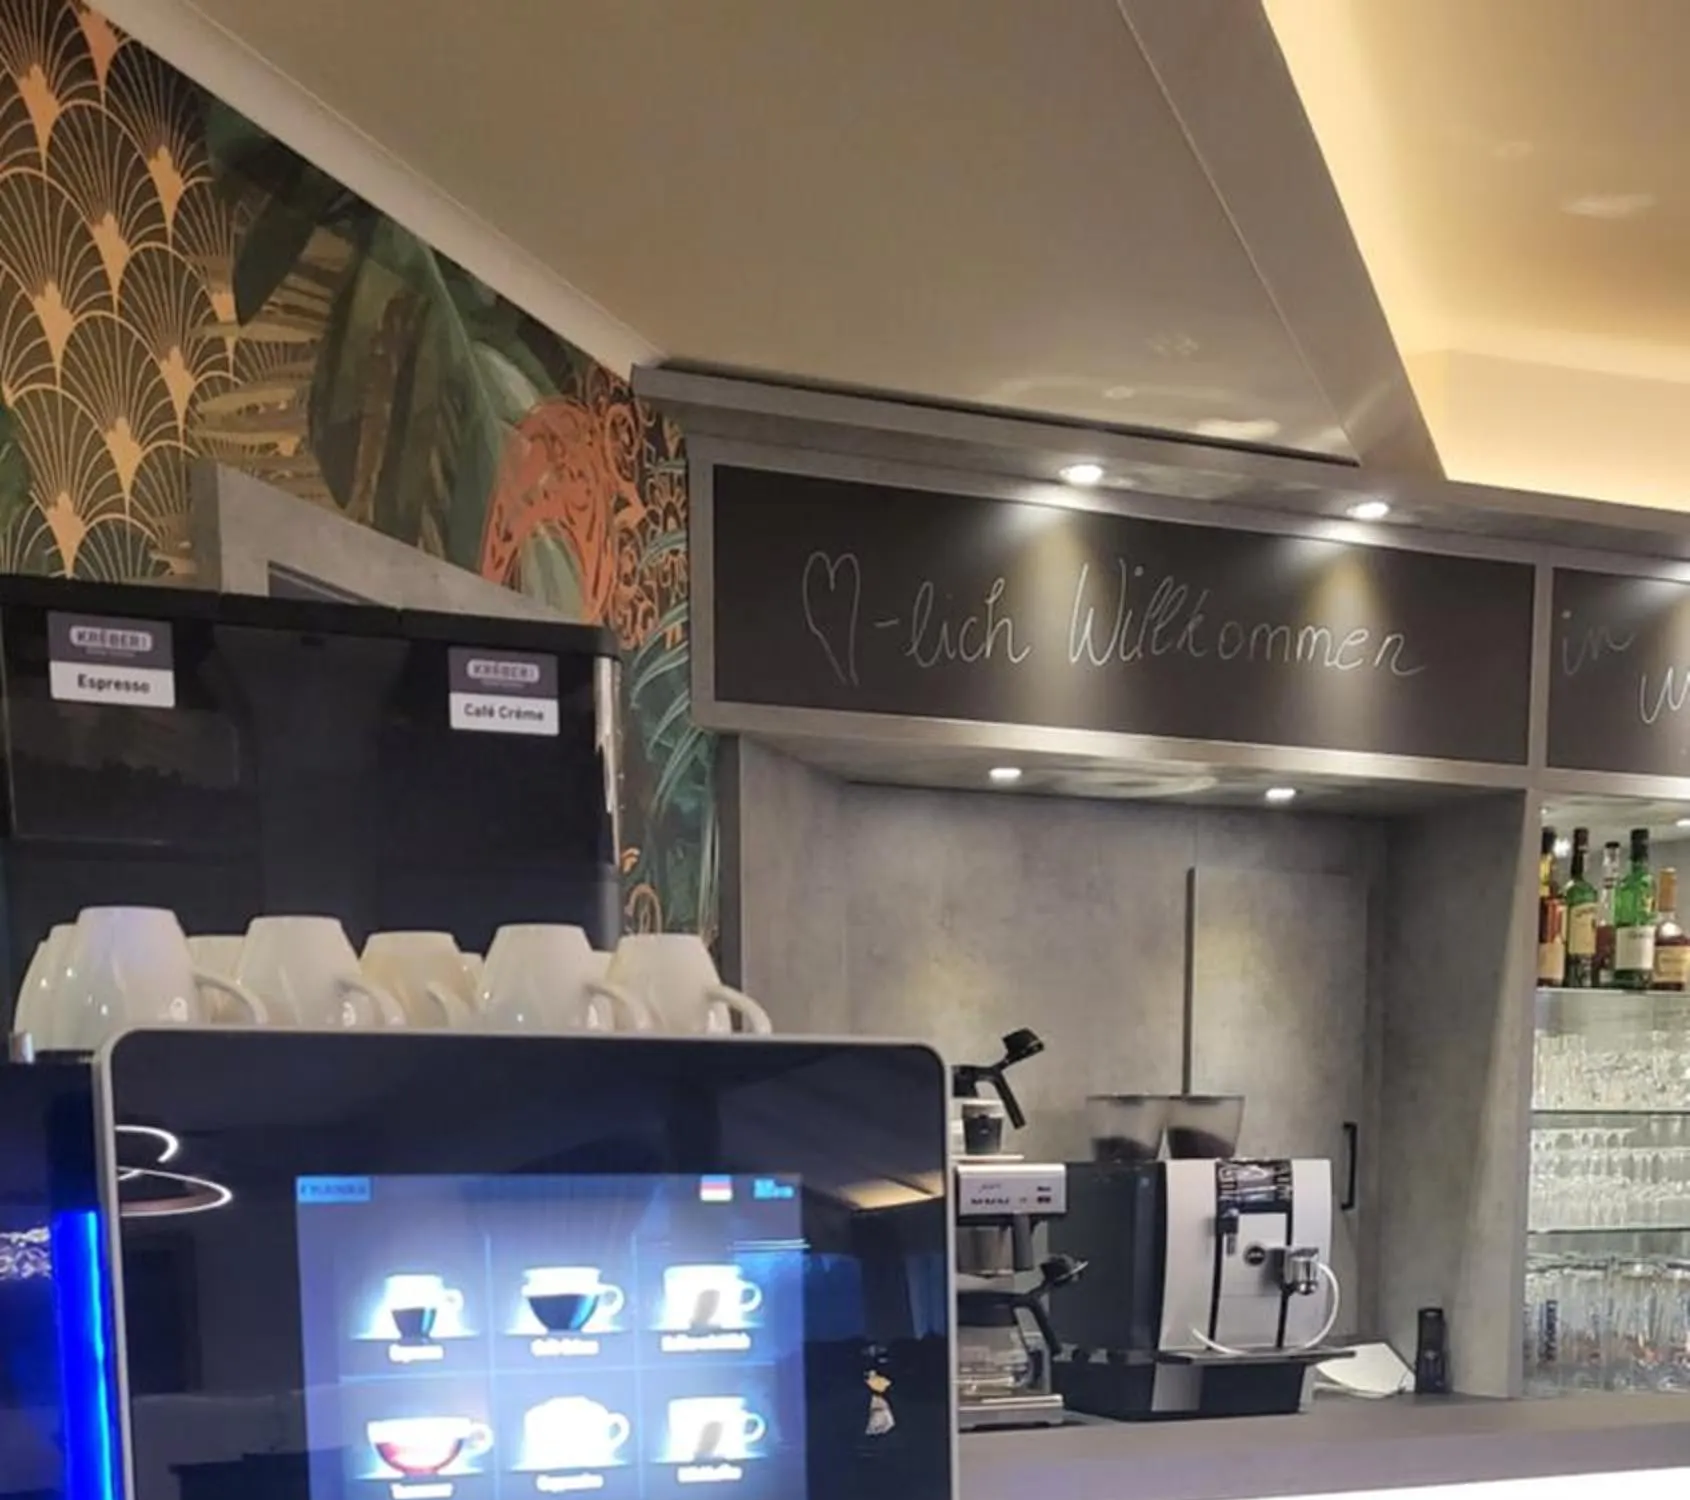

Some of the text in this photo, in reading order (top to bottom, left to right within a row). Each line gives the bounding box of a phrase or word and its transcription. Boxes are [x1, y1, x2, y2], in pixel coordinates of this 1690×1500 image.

[1069, 557, 1426, 677] Willkommen
[77, 673, 151, 695] Espresso
[464, 702, 495, 719] Café
